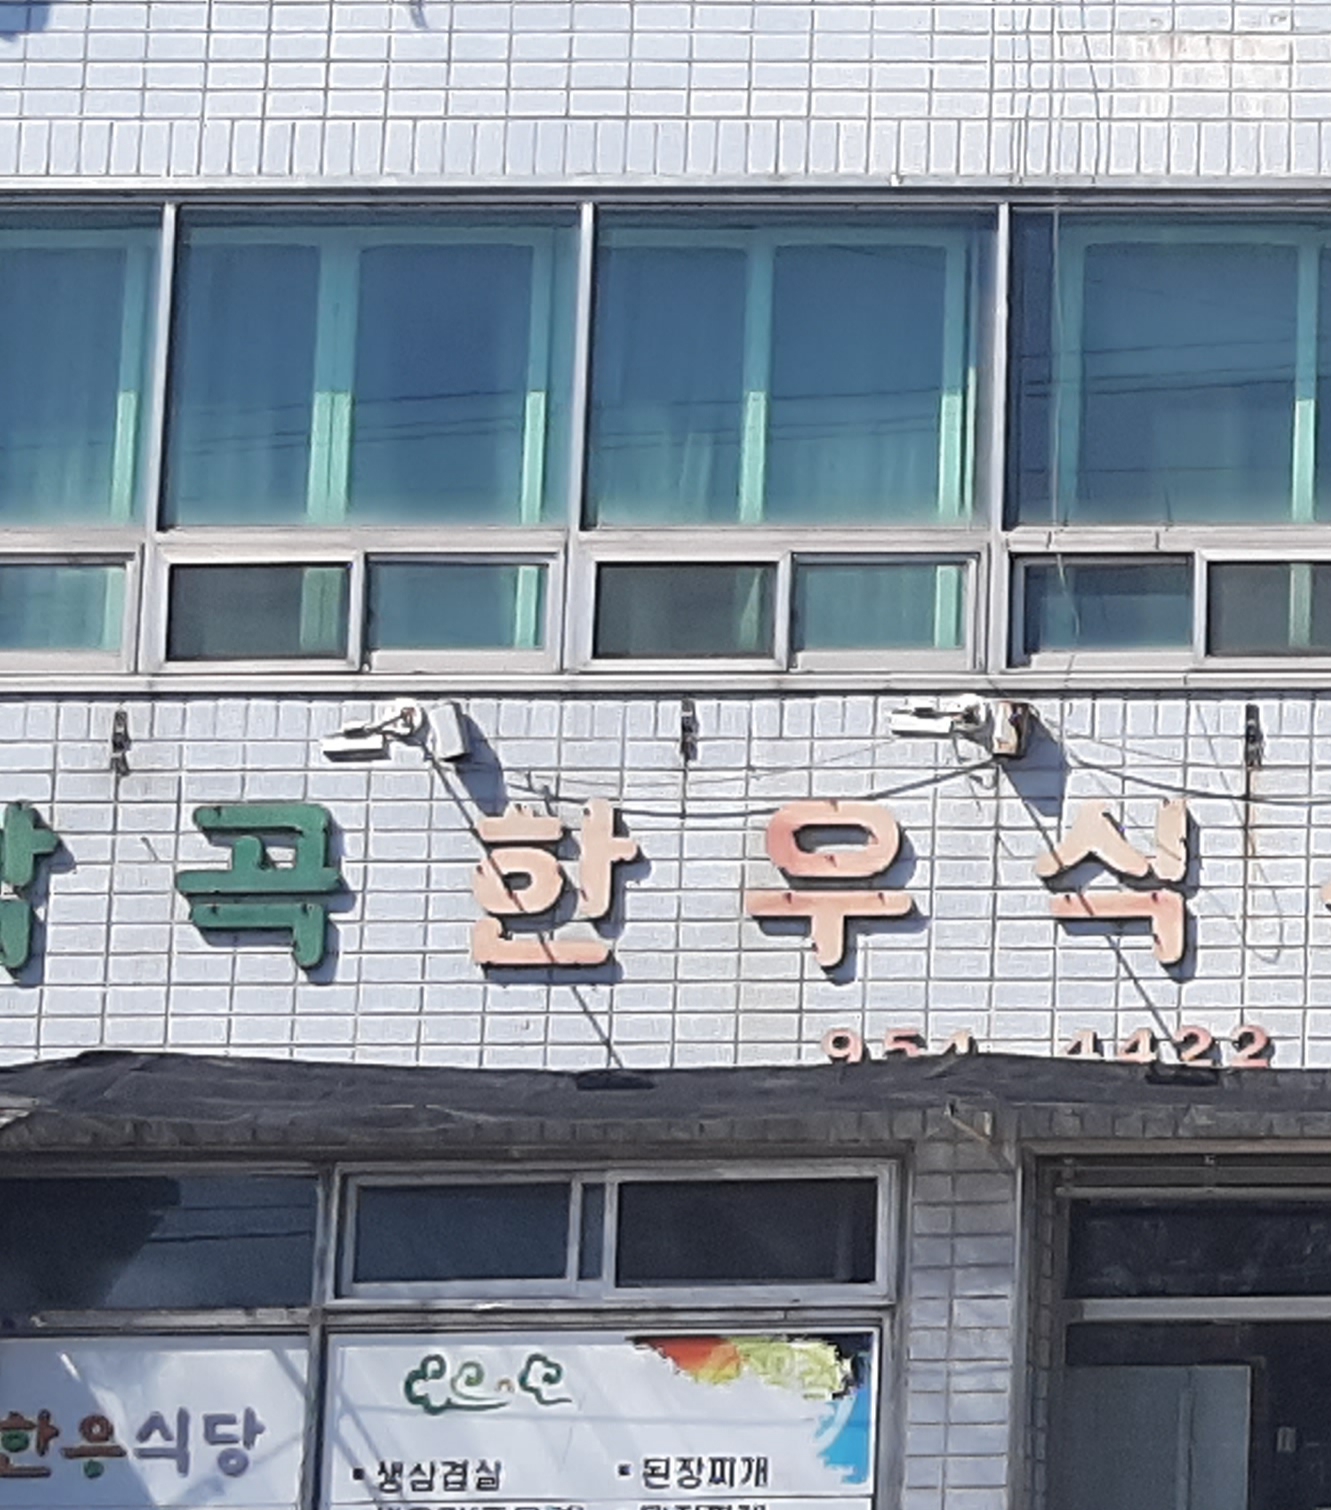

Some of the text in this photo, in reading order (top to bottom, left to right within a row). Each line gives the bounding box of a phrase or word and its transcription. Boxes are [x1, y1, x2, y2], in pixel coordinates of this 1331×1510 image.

[1065, 1025, 1270, 1068] 4422
[377, 1459, 502, 1494] 생삼겹살
[642, 1456, 769, 1490] 된장찌개
